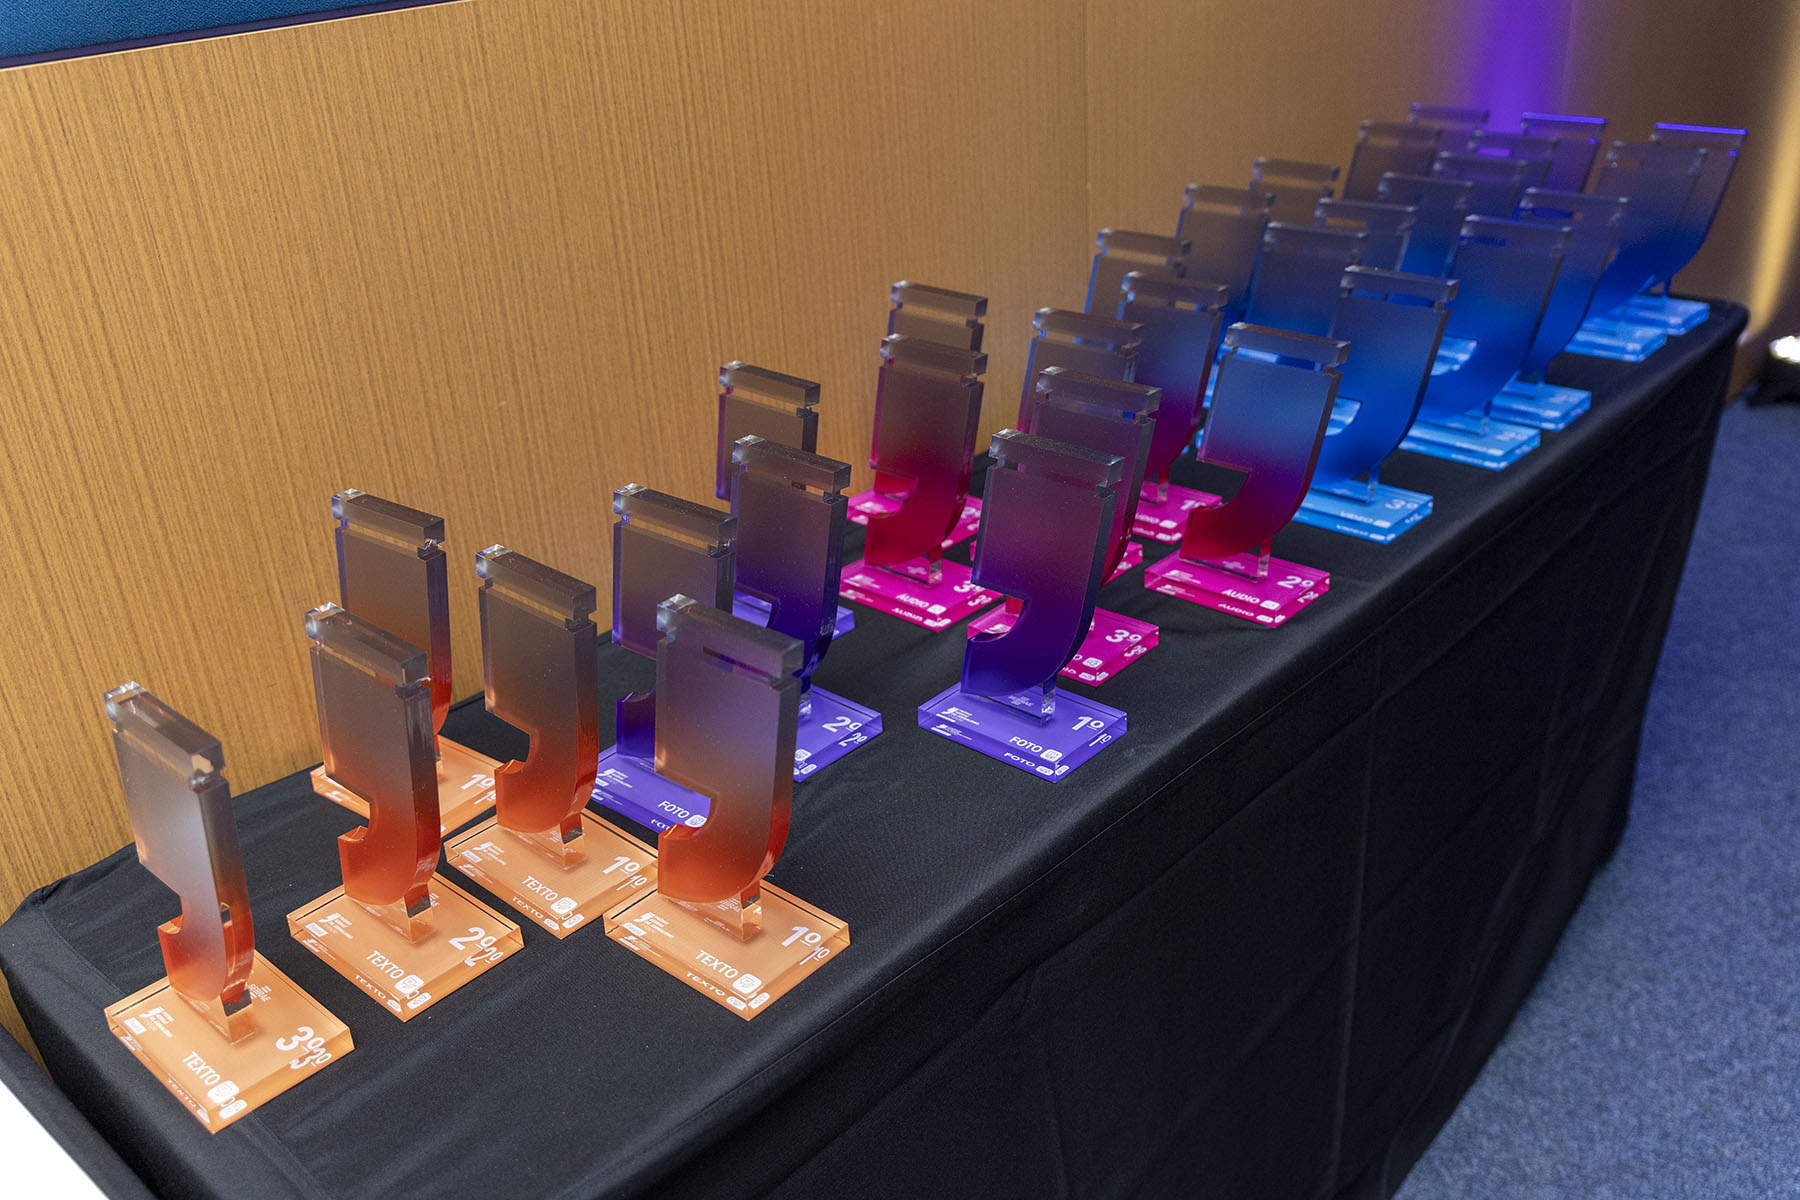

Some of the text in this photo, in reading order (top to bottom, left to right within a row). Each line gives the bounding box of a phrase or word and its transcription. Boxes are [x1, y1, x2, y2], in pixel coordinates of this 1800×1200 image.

[1276, 574, 1315, 589] 2º
[1105, 629, 1143, 645] 3º
[822, 716, 863, 733] 2º
[1071, 716, 1105, 731] 1º
[1008, 735, 1043, 754] FOTO
[657, 800, 690, 819] FOTO
[602, 856, 641, 876] 1º
[521, 875, 559, 902] TEXTO
[448, 926, 497, 952] 2º
[780, 925, 822, 948] 1º
[365, 950, 405, 980] TEXTO
[695, 949, 740, 979] TEXTO
[275, 1025, 327, 1055] 3º
[182, 1051, 221, 1086] TEXTO
